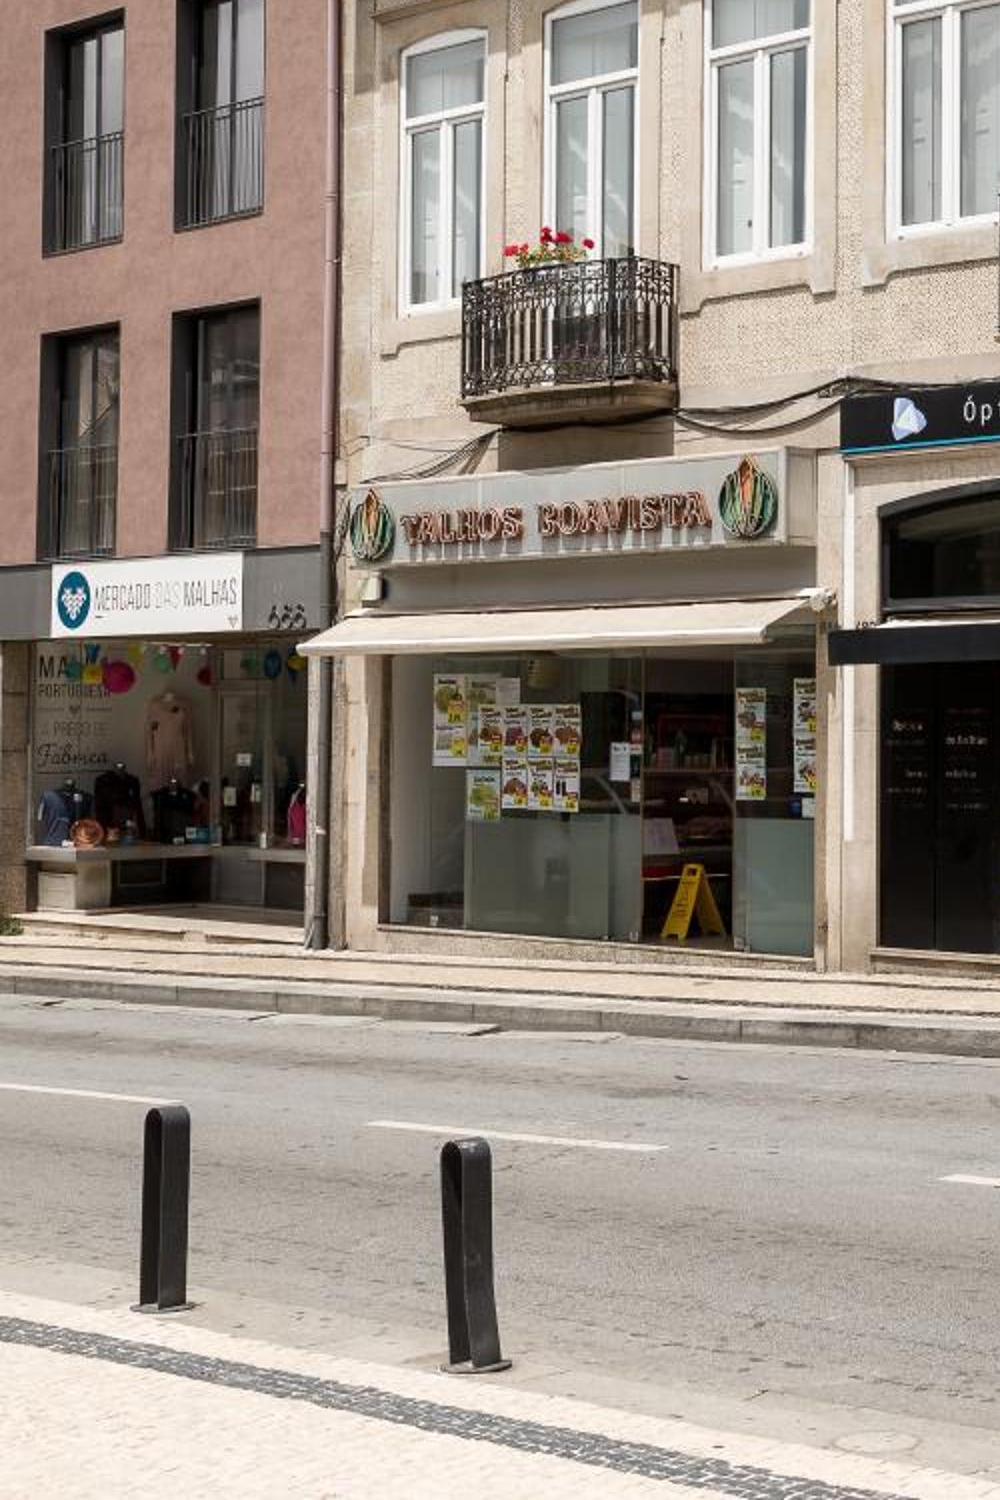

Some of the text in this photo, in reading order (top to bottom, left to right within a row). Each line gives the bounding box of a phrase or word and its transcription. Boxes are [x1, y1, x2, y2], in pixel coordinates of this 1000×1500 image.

[400, 492, 714, 545] TALHOS BOAVISTA
[94, 577, 238, 611] MERCADO DAS MALHAS
